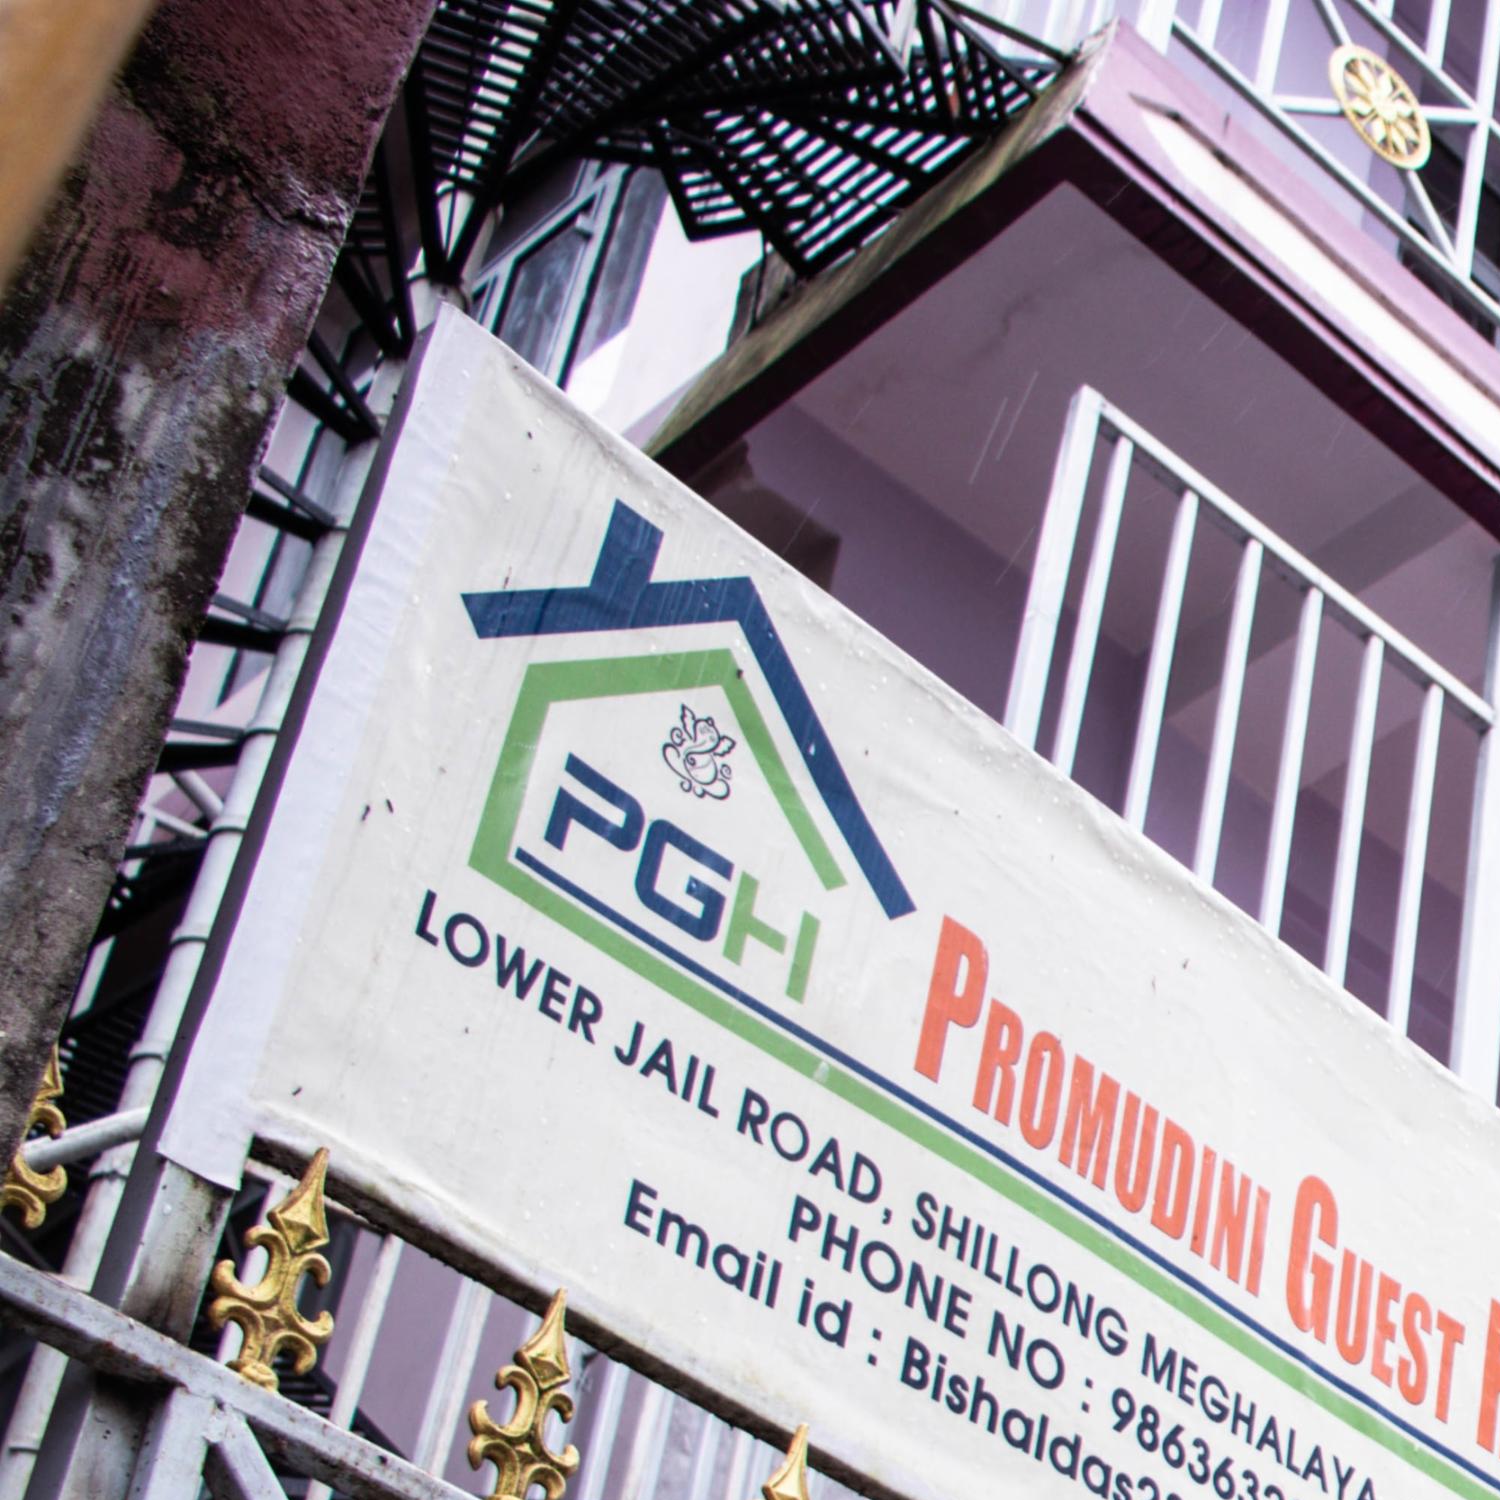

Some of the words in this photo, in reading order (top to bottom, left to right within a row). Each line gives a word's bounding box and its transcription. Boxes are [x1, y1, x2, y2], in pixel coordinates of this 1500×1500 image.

[415, 888, 604, 1045] LOWER
[613, 1020, 720, 1119] JAIL
[736, 1087, 893, 1225] ROAD,
[910, 1191, 1129, 1357] SHILLONG
[623, 1178, 783, 1309] Email
[796, 1277, 853, 1349] id
[914, 915, 1269, 1296] PROMUDINI
[1286, 1176, 1465, 1423] GUEST
[787, 1194, 973, 1339] PHONE
[986, 1309, 1066, 1391] NO
